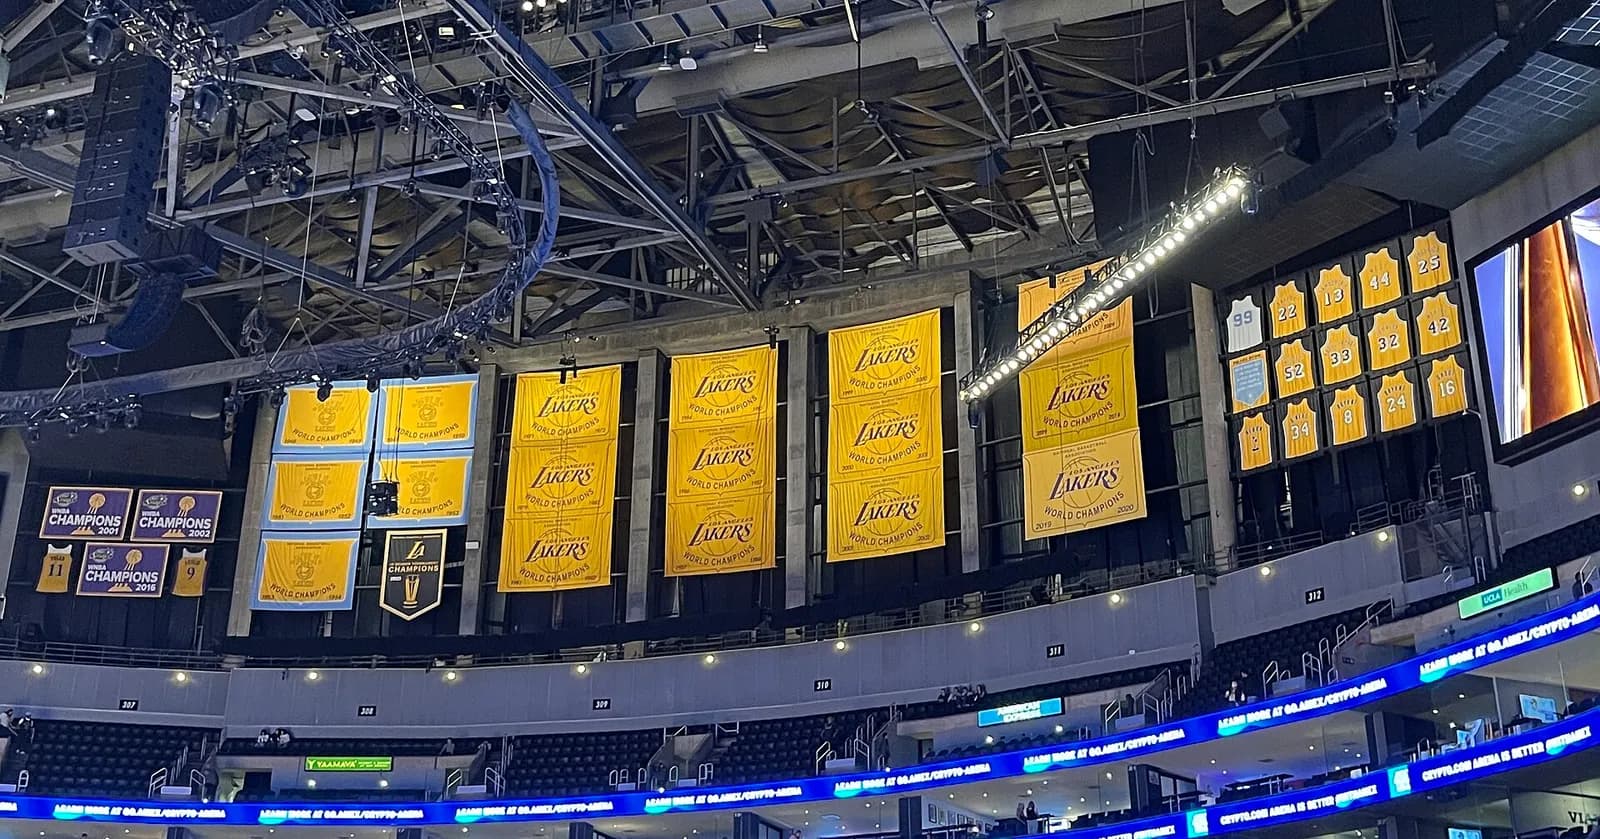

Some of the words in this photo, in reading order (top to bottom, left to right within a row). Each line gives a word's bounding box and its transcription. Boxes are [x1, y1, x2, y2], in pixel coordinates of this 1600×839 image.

[1417, 255, 1441, 274] 25
[1370, 272, 1390, 291] 44
[1324, 288, 1344, 306] 13
[1233, 310, 1253, 328] 99
[1278, 304, 1297, 322] 22
[1066, 311, 1109, 338] HAMPIONS
[1428, 318, 1448, 335] 42
[1378, 334, 1399, 351] 32
[854, 345, 919, 372] LAKERS
[1330, 349, 1351, 367] 33
[849, 378, 875, 390] WORLD
[876, 364, 921, 390] CHAMPIONS
[1284, 363, 1303, 380] 52
[692, 375, 757, 399] LAKERS
[1047, 380, 1111, 411] LAKERS
[1439, 380, 1456, 398] 16
[536, 396, 600, 418] LAKERS
[688, 403, 714, 416] WORLD
[715, 396, 758, 416] CHAMPIONS
[1386, 394, 1406, 413] 24
[1043, 415, 1069, 429] WORLD
[1070, 401, 1114, 429] CHAMPIONS
[1343, 409, 1353, 425] 8
[394, 424, 418, 438] WORLD
[418, 422, 460, 439] CHAMPIONS
[530, 421, 556, 436] WORLD
[557, 417, 600, 436] CHAMPIONS
[854, 419, 919, 446] LAKERS
[1291, 422, 1309, 441] 34
[292, 428, 316, 443] WORLD
[317, 428, 357, 443] CHAMPIONS
[690, 447, 756, 471] LAKERS
[849, 452, 875, 465] WORLD
[876, 441, 921, 465] CHAMPIONS
[529, 464, 596, 488] LAKERS
[686, 476, 712, 489] WORLD
[712, 468, 757, 489] CHAMPIONS
[1049, 466, 1121, 501] LAKERS
[525, 493, 550, 508] WORLD
[550, 488, 595, 508] CHAMPIONS
[1044, 505, 1074, 520] WORLD
[1074, 491, 1124, 520] CHAMPIONS
[279, 503, 304, 517] WORLD
[304, 503, 346, 518] CHAMPIONS
[854, 499, 920, 527] LAKERS
[1116, 503, 1135, 514] 2020
[49, 515, 121, 527] CHAMPIONS
[139, 517, 212, 530] CHAMPIONS
[1035, 521, 1052, 530] 2019
[97, 527, 119, 535] 2001
[188, 529, 210, 538] 2002
[687, 522, 753, 547] LAKERS
[849, 532, 877, 546] WORLD
[877, 522, 924, 547] CHAMPIONS
[524, 538, 590, 563] LAKERS
[683, 551, 710, 566] WORLD
[711, 544, 756, 567] CHAMPIONS
[49, 563, 63, 578] 11
[85, 571, 159, 583] CHAMPIONS
[187, 567, 196, 580] 9
[388, 563, 440, 574] CHAMPIONS
[519, 566, 546, 583] WORLD
[545, 563, 591, 584] CHAMPIONS
[135, 583, 157, 592] 2016
[270, 583, 295, 598] WORLD
[294, 583, 336, 599] CHAMPIONS
[1308, 590, 1322, 602] 312
[1484, 592, 1501, 605] UCLA
[1504, 581, 1528, 598] Health
[1050, 646, 1062, 656] 311
[1475, 644, 1487, 658] AT
[816, 681, 829, 690] 310
[121, 701, 137, 709] 307
[360, 706, 374, 715] 308
[595, 700, 609, 709] 309
[1272, 706, 1284, 718] AT
[1077, 748, 1089, 759] AT
[886, 777, 897, 787] AT
[696, 795, 707, 804] AT
[110, 807, 122, 816] AT
[312, 810, 324, 819] AT
[506, 806, 517, 815] AT
